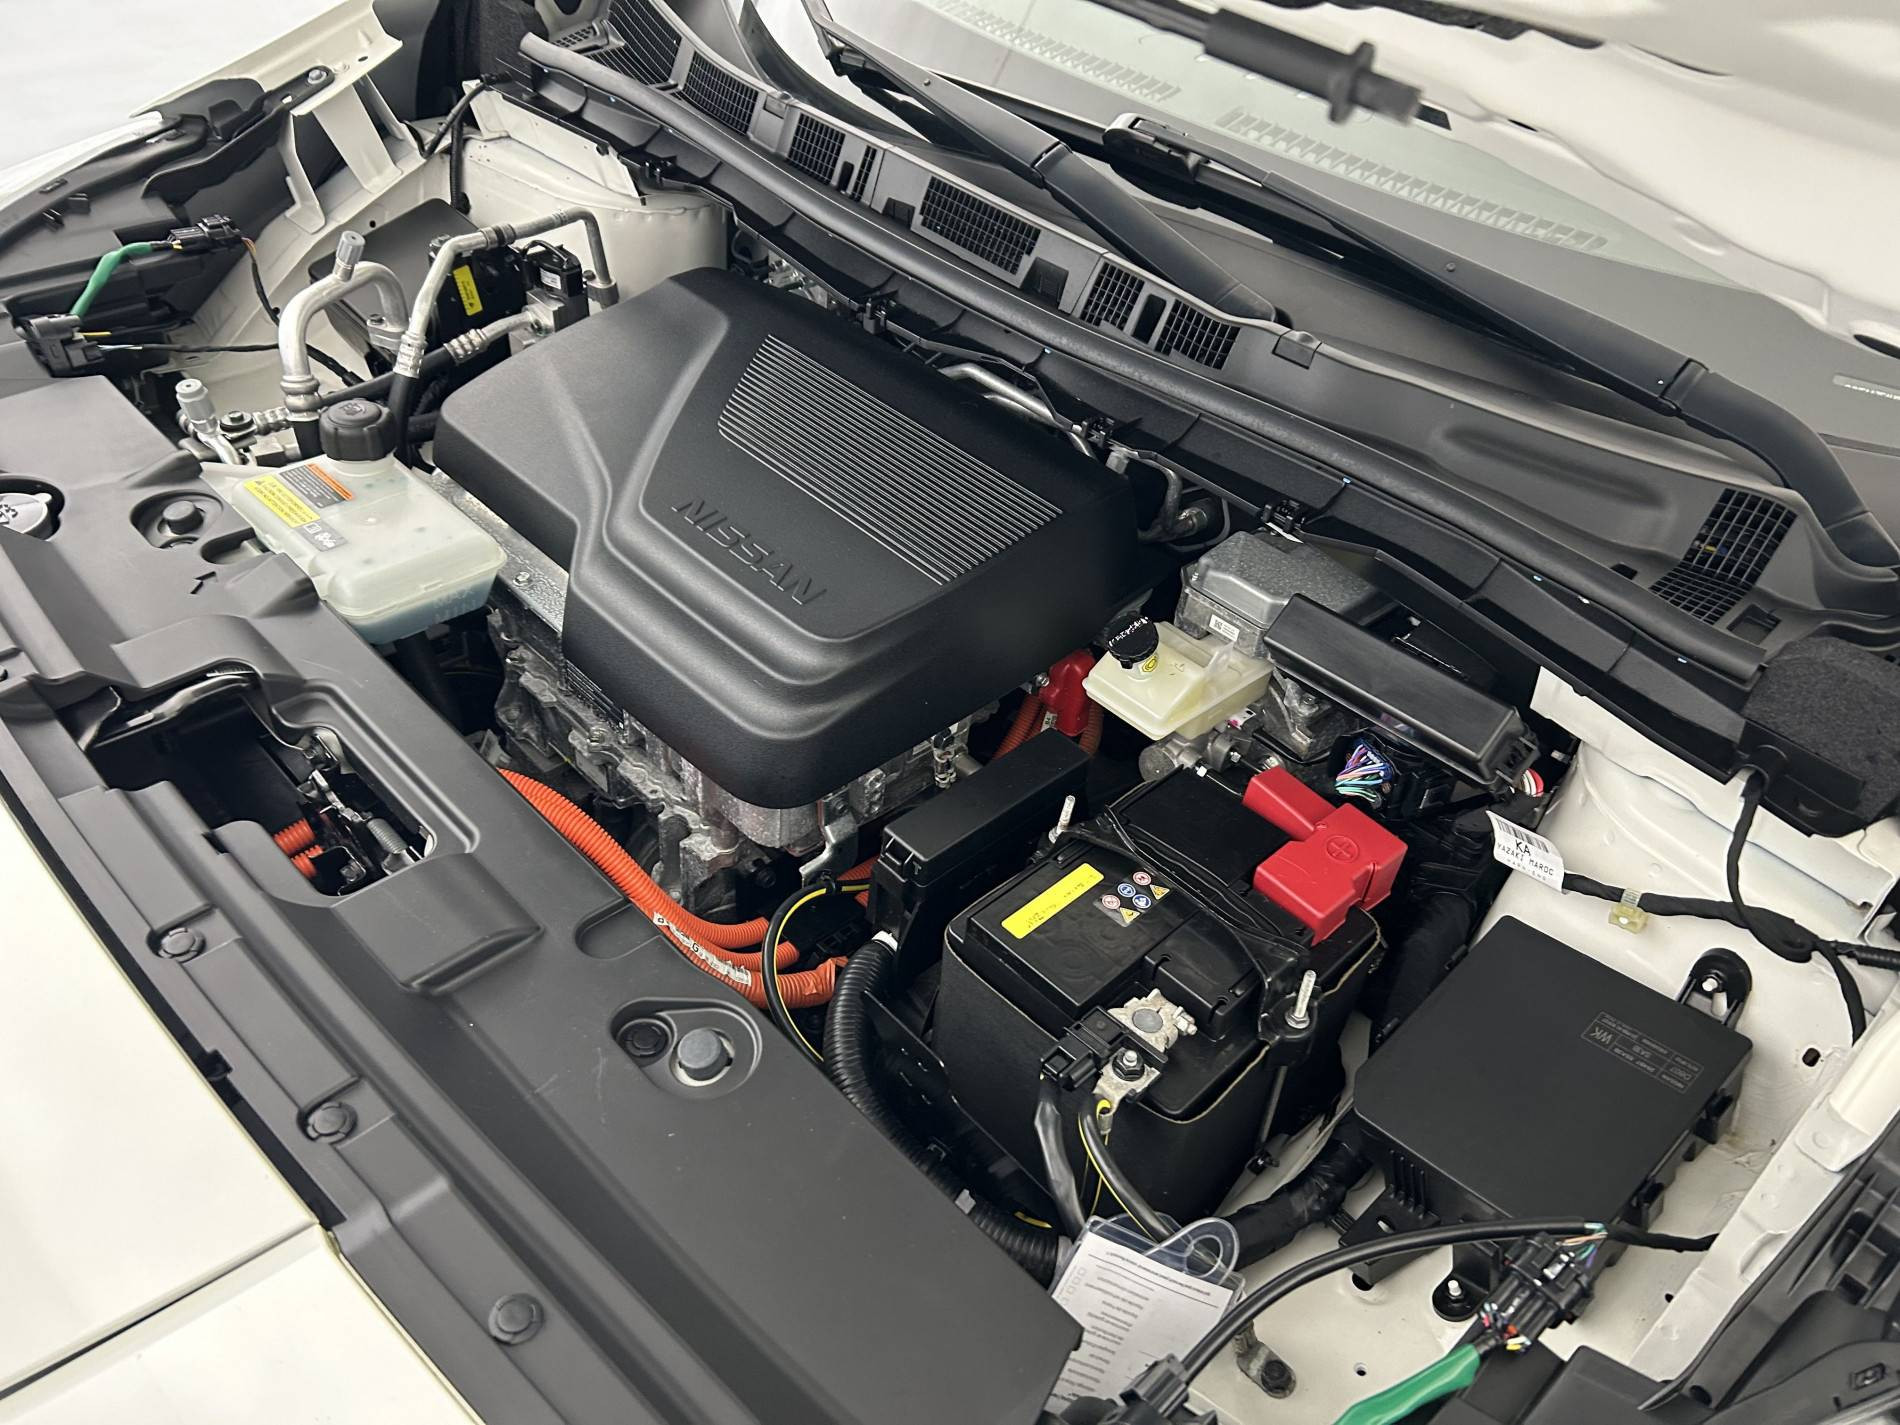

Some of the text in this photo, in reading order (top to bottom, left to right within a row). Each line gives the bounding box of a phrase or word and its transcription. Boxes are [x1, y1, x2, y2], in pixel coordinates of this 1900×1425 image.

[671, 498, 827, 605] NISSAN
[1497, 842, 1554, 876] YAZAKI MAROC
[1515, 839, 1531, 856] KA
[1590, 1026, 1614, 1045] WK
